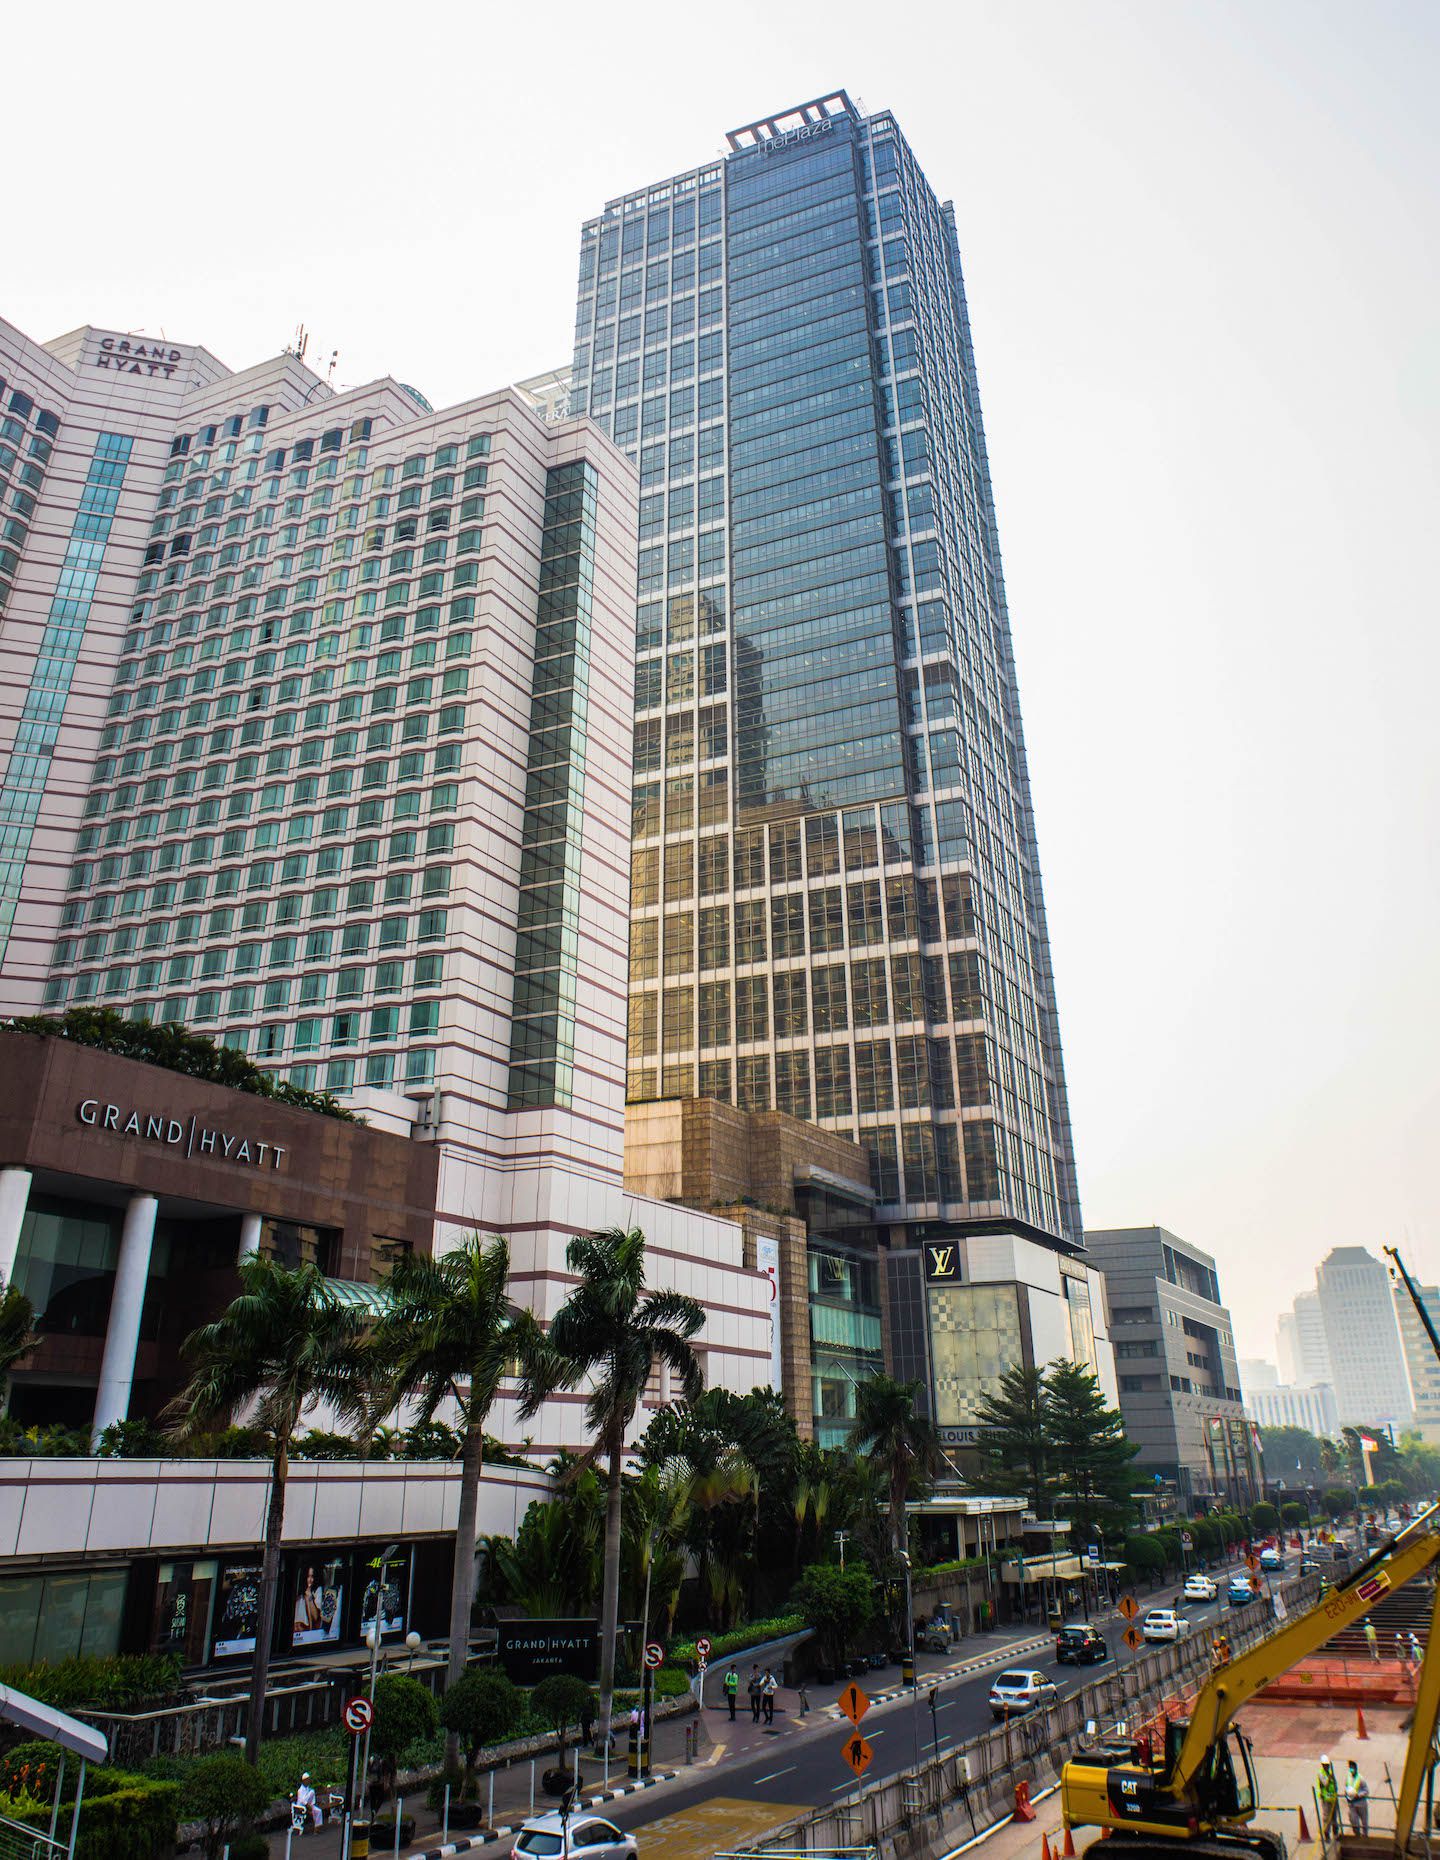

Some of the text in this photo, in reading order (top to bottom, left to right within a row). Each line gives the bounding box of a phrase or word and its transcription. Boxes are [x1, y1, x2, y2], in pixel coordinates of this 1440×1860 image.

[101, 338, 181, 361] GRAND
[97, 356, 175, 379] HYATT
[80, 1100, 286, 1169] GRAND HYATT
[942, 1431, 974, 1442] LOUIS
[506, 1639, 590, 1649] GRAND HYATT
[1121, 1780, 1137, 1795] CAT
